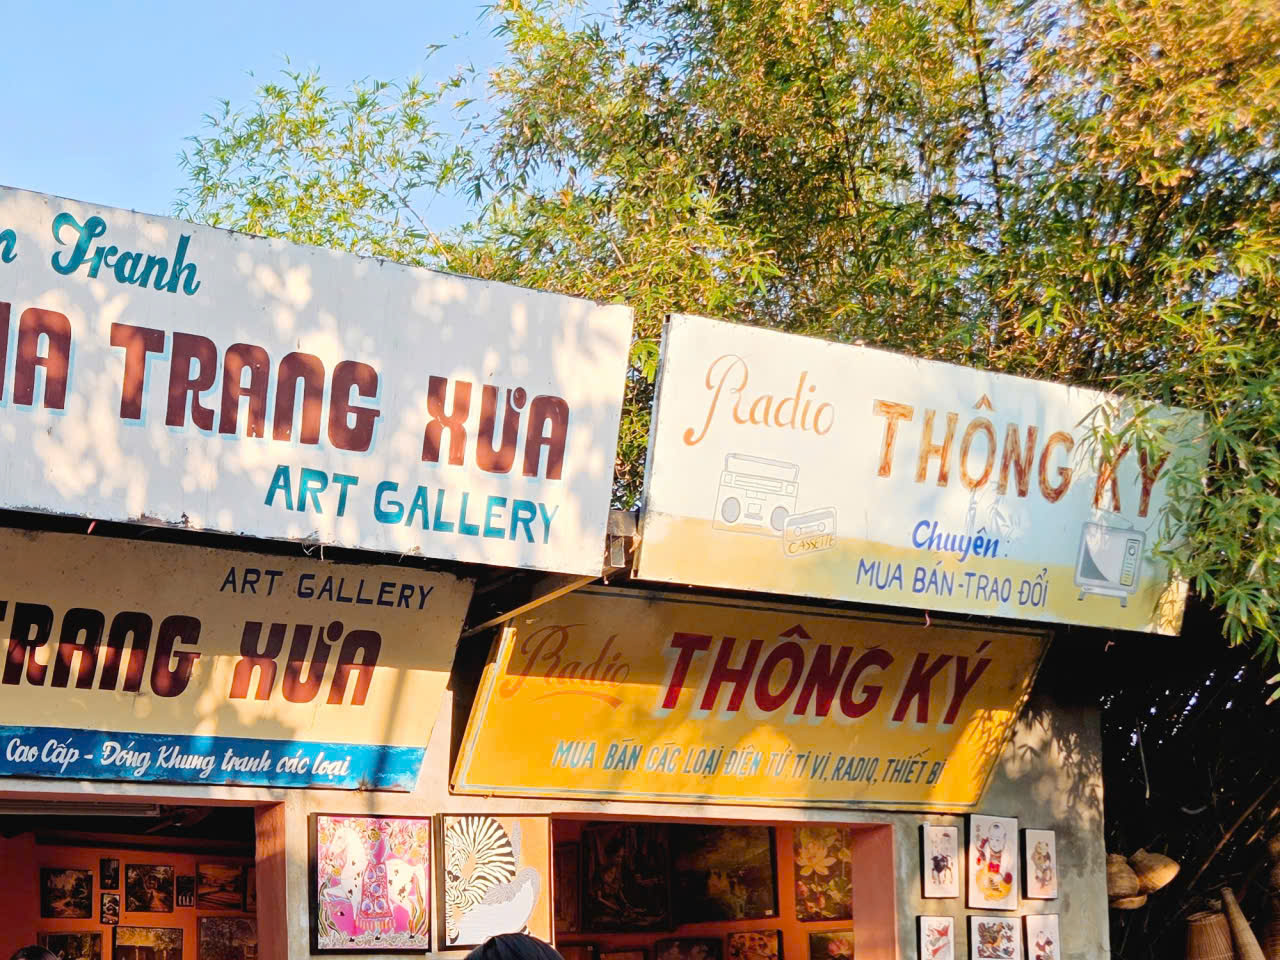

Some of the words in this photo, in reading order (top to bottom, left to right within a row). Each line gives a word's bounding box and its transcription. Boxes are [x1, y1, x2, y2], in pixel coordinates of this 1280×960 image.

[51, 211, 201, 296] Tranh
[110, 322, 380, 455] TRANG
[422, 374, 571, 482] XƯA
[683, 353, 835, 447] Radio
[873, 392, 1075, 503] THÔNG
[264, 464, 359, 517] ART
[373, 480, 559, 545] GALLERY
[220, 566, 284, 597] ART
[296, 573, 435, 610] GALLERY
[856, 558, 904, 590] MUA
[1017, 568, 1049, 607] ĐỔI
[228, 620, 382, 706] XƯA
[499, 623, 631, 698] Radio
[660, 624, 895, 720] THÔNG
[890, 640, 992, 725] KÝ
[5, 737, 40, 763] Cao
[40, 737, 81, 774] Cấp
[100, 741, 151, 776] Đóng
[155, 745, 217, 778] Khung
[220, 748, 272, 773] tranh
[276, 749, 310, 775] các
[311, 751, 351, 780] loại
[551, 739, 597, 769] MUA
[602, 738, 644, 771] BÁN
